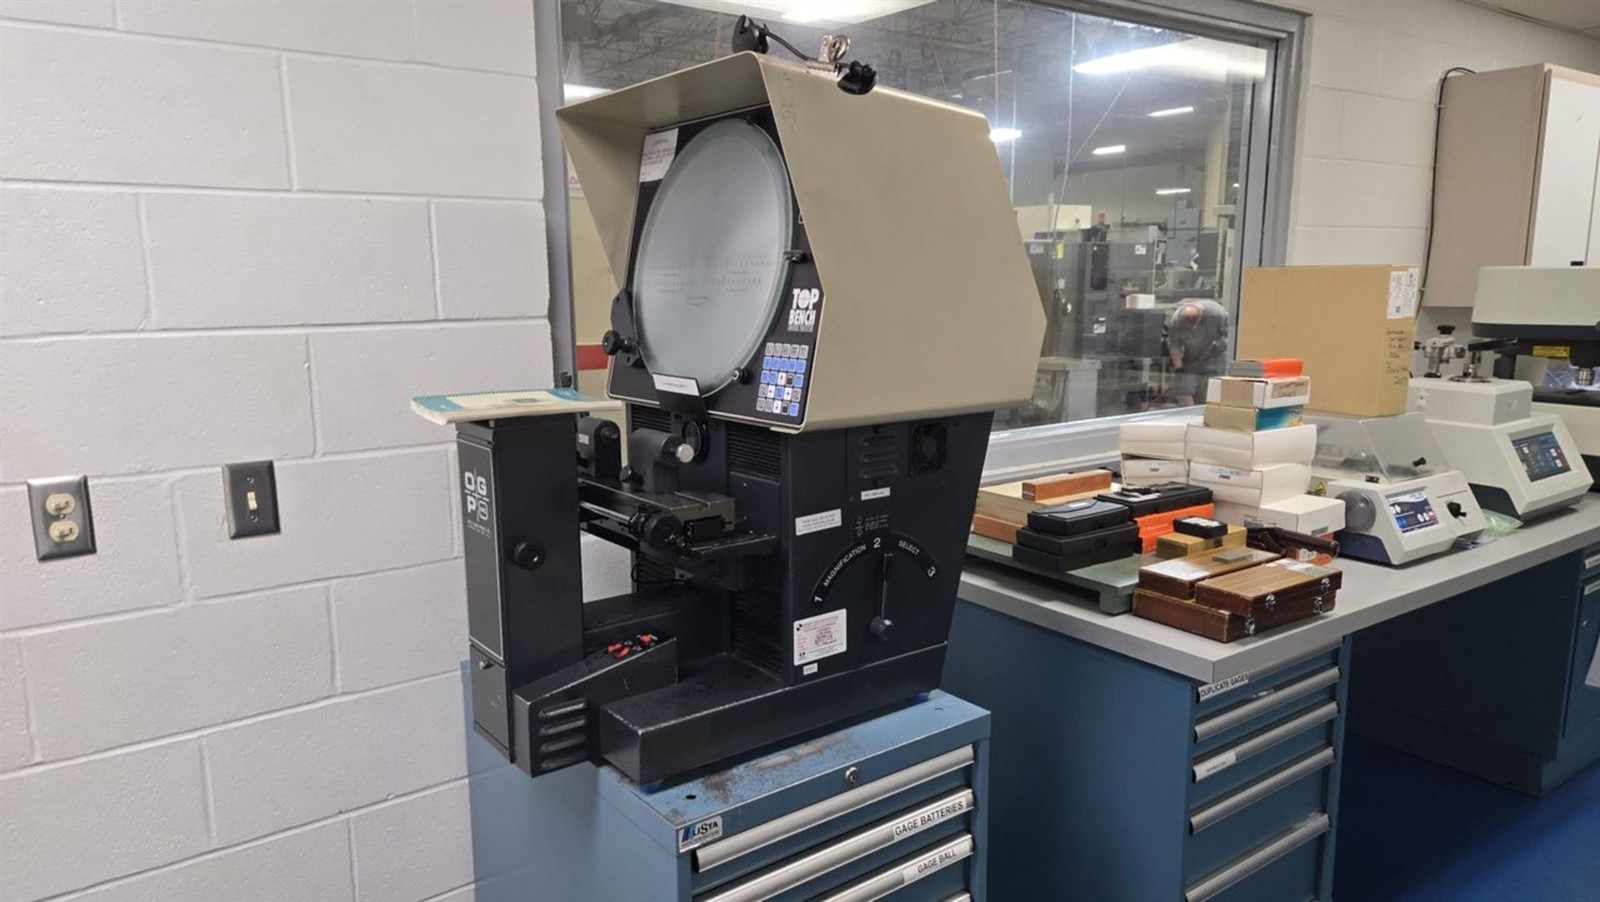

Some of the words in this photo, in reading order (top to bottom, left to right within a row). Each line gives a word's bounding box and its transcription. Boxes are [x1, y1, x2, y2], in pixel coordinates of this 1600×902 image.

[792, 288, 820, 310] TOP
[788, 310, 816, 326] BENCH
[873, 537, 881, 548] 2
[823, 544, 867, 587] MAGNIFICATION
[898, 540, 920, 556] SELECT
[927, 566, 936, 577] 3
[1200, 679, 1230, 698] DUPLICATE
[1230, 672, 1249, 687] GAGES
[894, 818, 919, 836] GAGE
[920, 800, 964, 826] BATTERIES
[917, 856, 938, 874] GAGE
[938, 849, 956, 863] BALL
